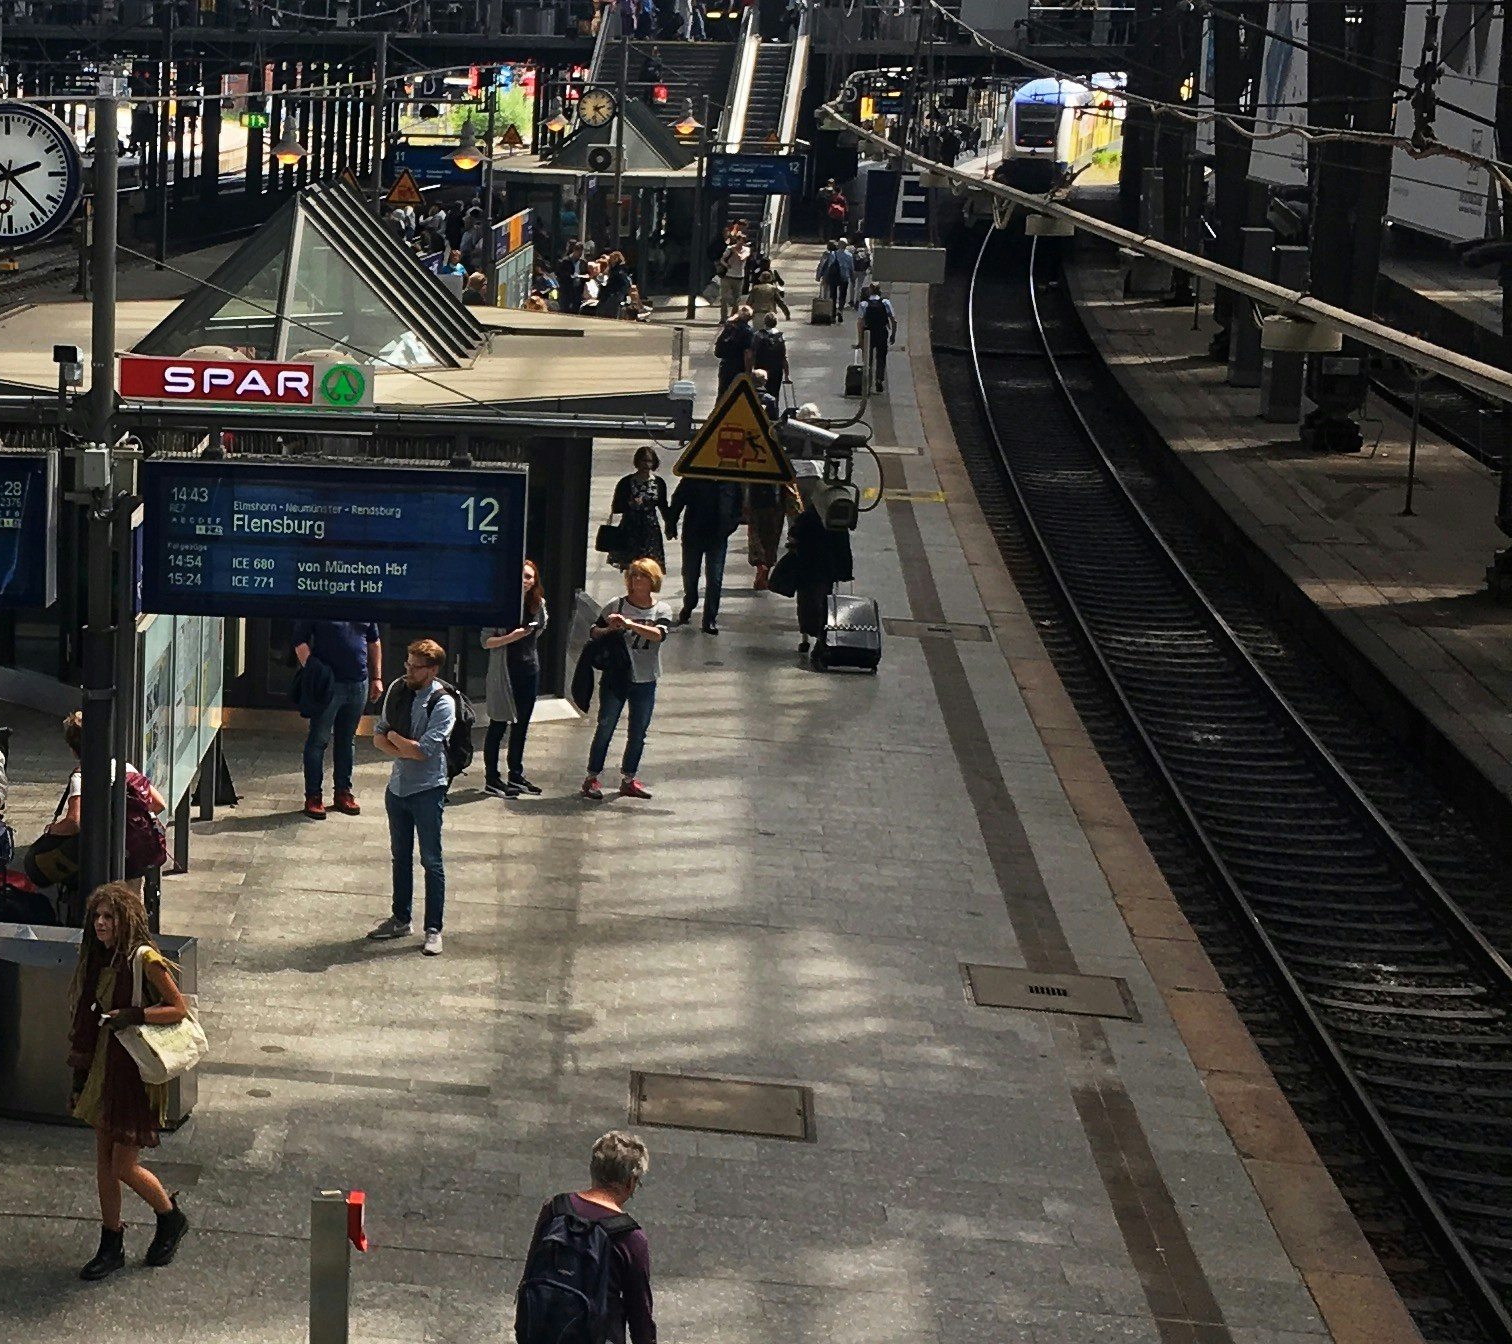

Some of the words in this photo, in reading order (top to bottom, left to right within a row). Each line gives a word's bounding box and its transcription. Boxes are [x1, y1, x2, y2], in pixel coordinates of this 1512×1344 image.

[894, 174, 926, 224] E
[164, 365, 310, 398] SPAR
[171, 487, 209, 503] 14:43
[233, 501, 277, 512] Elmshorn
[285, 503, 342, 514] Neumünster
[351, 505, 402, 519] Rendsburg
[460, 496, 500, 532] 12
[233, 514, 325, 539] Flensburg
[479, 534, 498, 544] C-F
[168, 555, 202, 567] 14:54
[232, 557, 250, 569] ICE
[253, 558, 275, 570] 680
[298, 562, 321, 572] von
[325, 561, 381, 575] München
[385, 562, 408, 576] Hbf
[167, 572, 202, 586] 15:24
[231, 575, 249, 587] ICE
[253, 576, 275, 588] 771
[297, 578, 355, 594] Stuttgart
[360, 580, 383, 593] Hbf
